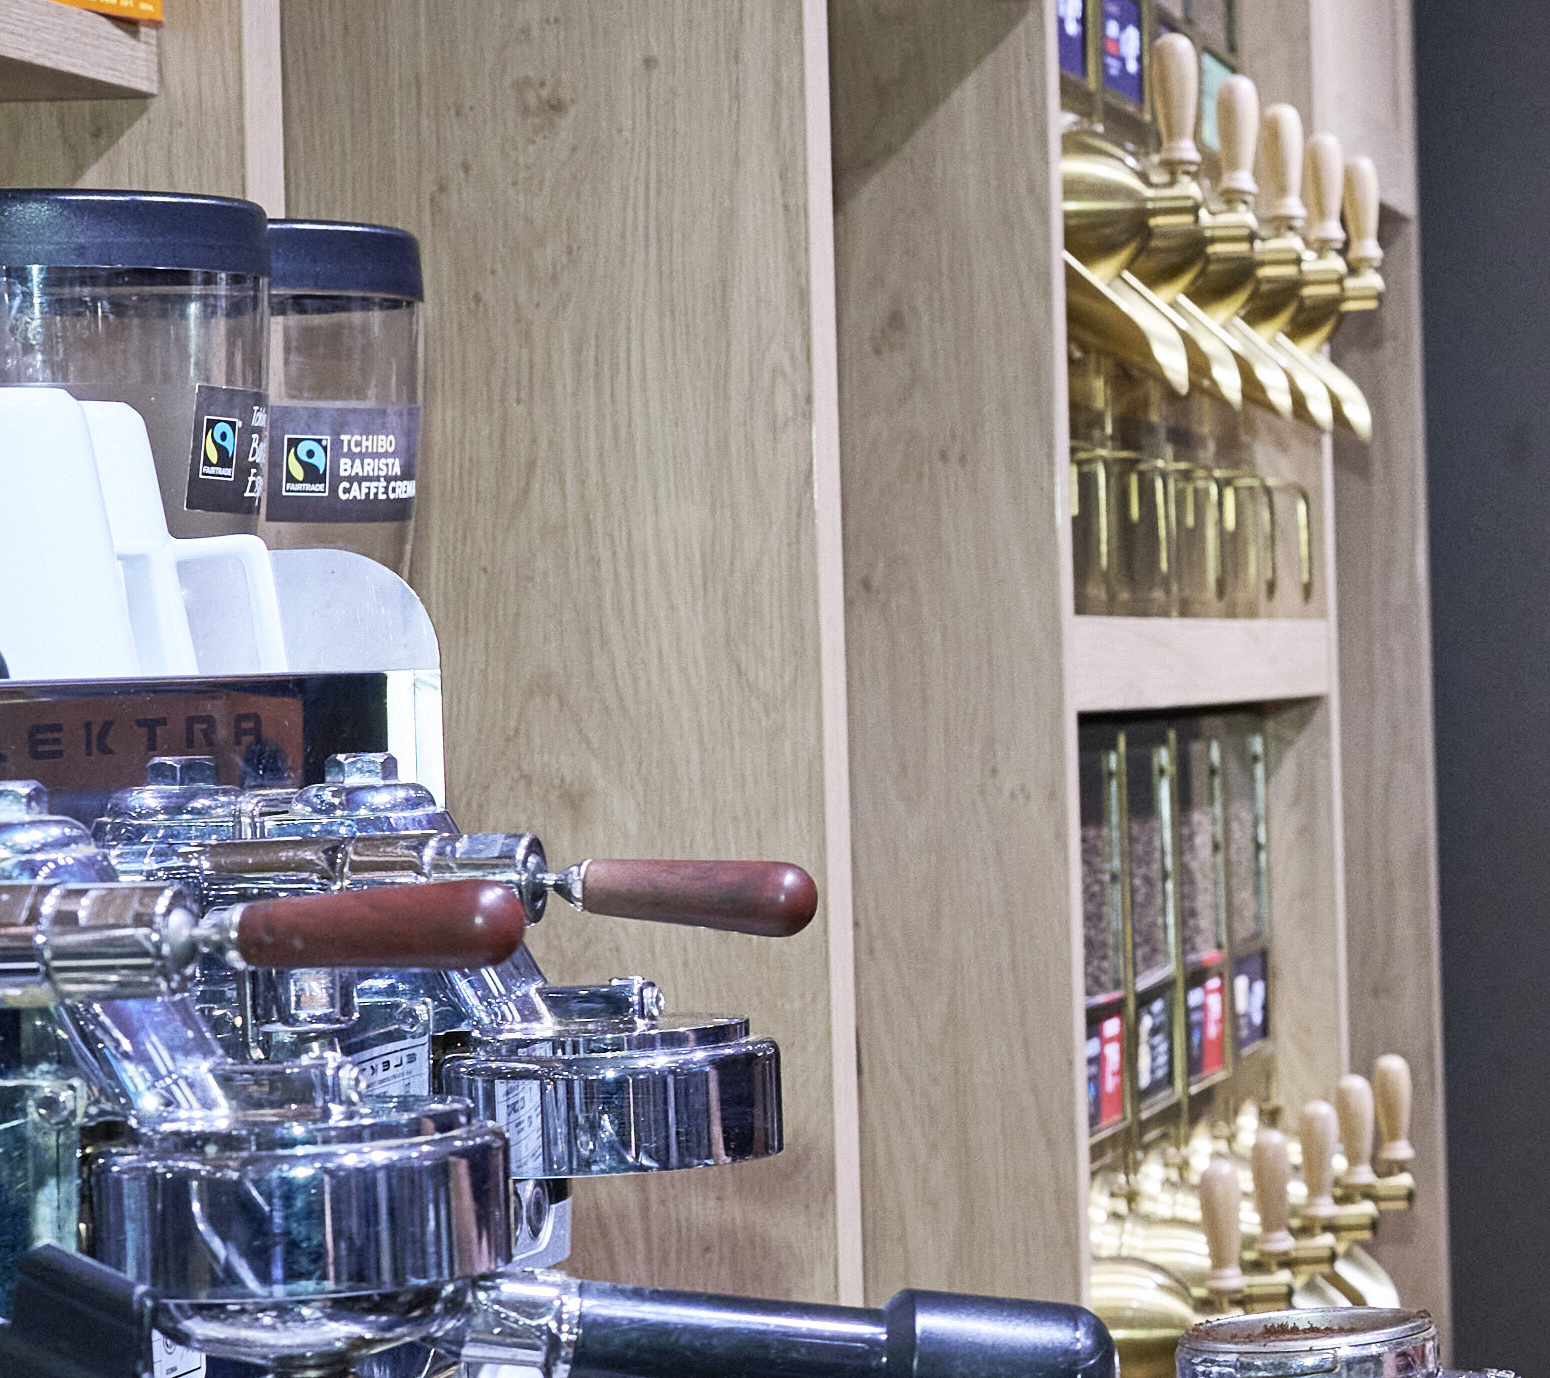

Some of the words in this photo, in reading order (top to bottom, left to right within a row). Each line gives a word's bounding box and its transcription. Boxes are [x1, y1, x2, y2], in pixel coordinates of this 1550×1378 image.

[340, 434, 396, 454] TCHIBO
[202, 466, 233, 477] FAIRTRADE
[339, 458, 401, 477] BARISTA
[286, 483, 325, 492] FAIRTRADE
[338, 477, 388, 501] CAFFÈ
